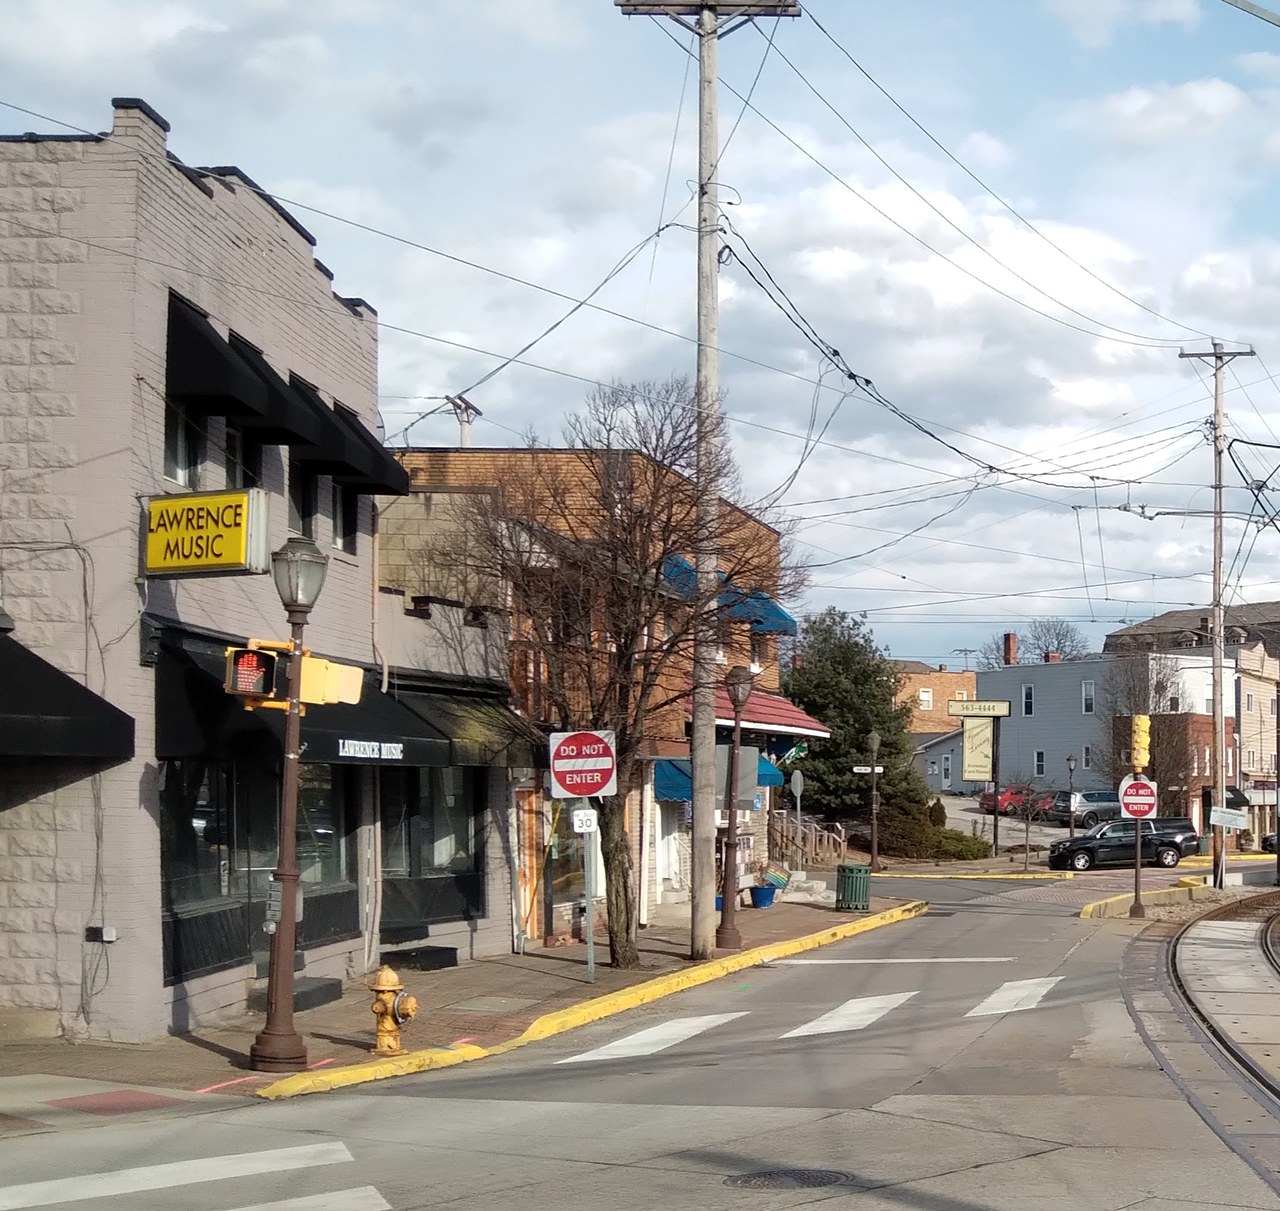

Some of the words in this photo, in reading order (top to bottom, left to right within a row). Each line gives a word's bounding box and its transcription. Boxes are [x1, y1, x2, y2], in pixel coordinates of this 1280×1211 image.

[148, 503, 243, 533] LAWRENCE
[163, 533, 224, 561] MUSIC
[560, 745, 577, 757] DO
[582, 743, 605, 755] NOT
[566, 772, 602, 785] ENTER
[1138, 788, 1152, 796] NOT
[577, 818, 593, 828] 30
